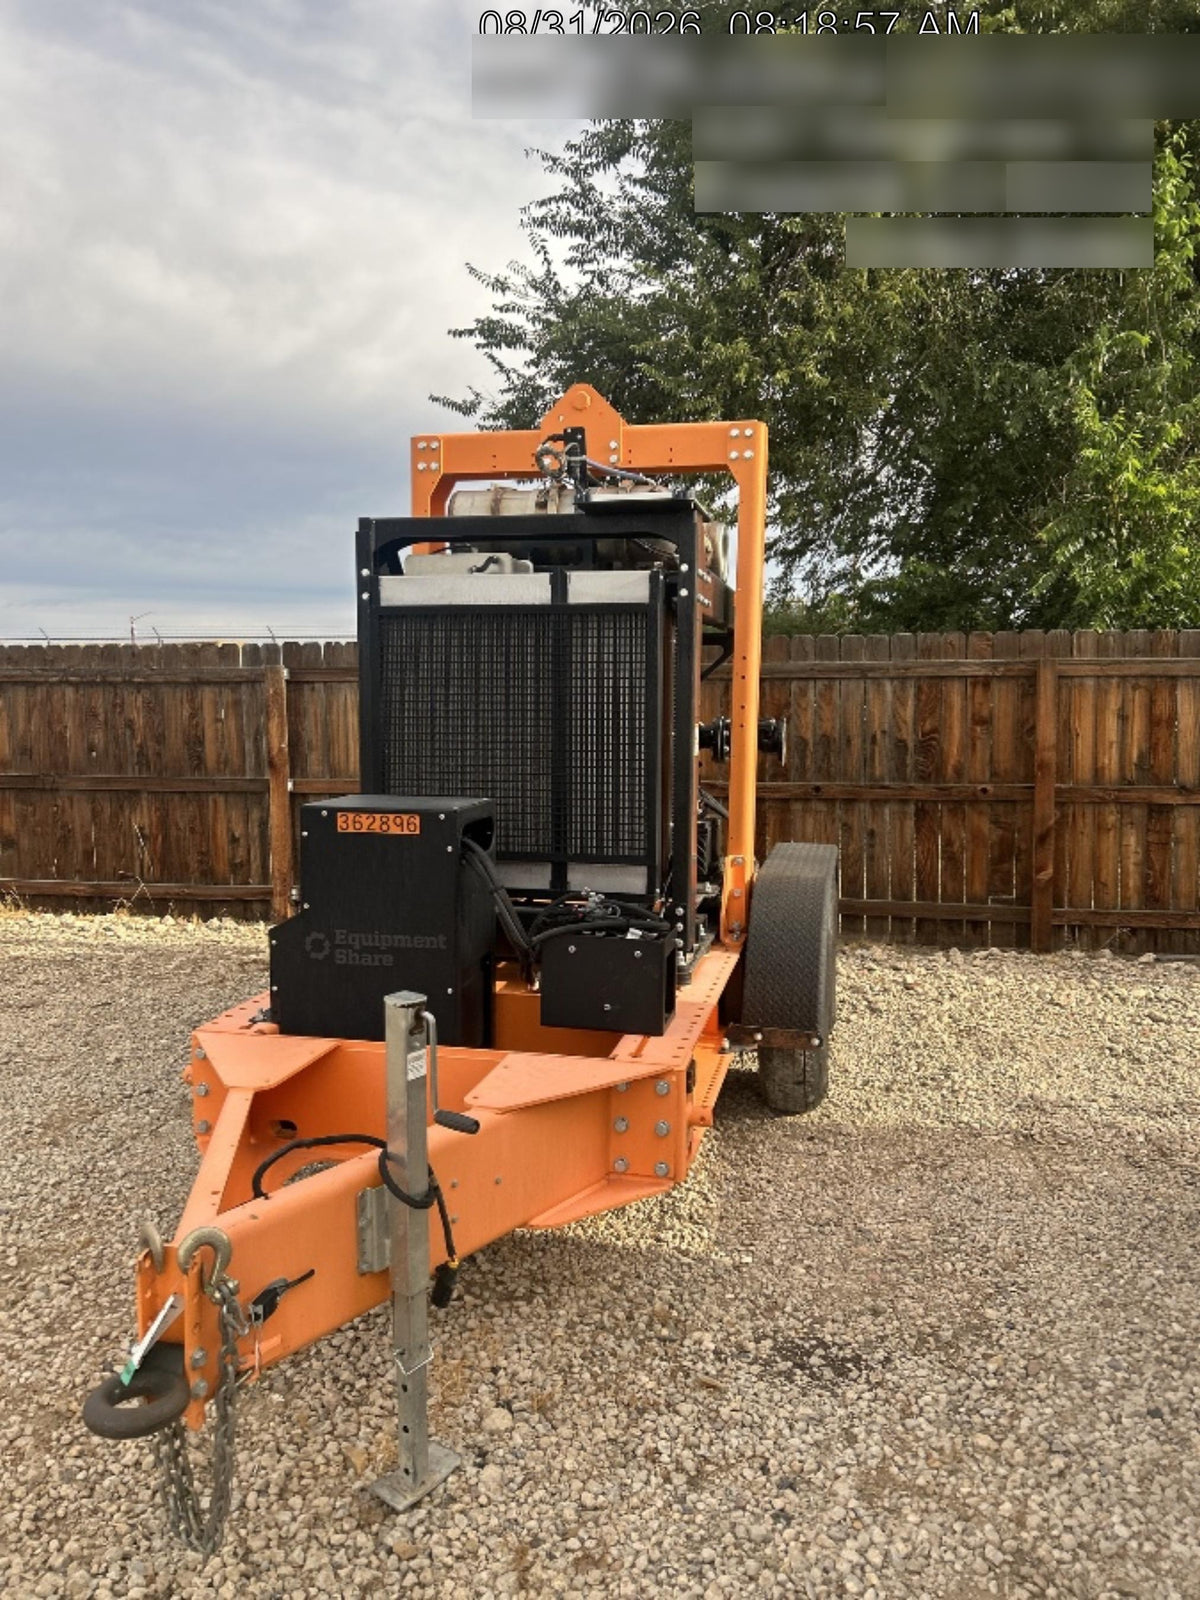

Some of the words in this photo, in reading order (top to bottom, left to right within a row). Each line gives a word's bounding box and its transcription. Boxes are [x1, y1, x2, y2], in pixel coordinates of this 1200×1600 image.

[339, 813, 417, 832] 362896
[334, 929, 447, 950] Equipment
[334, 949, 394, 966] Share
